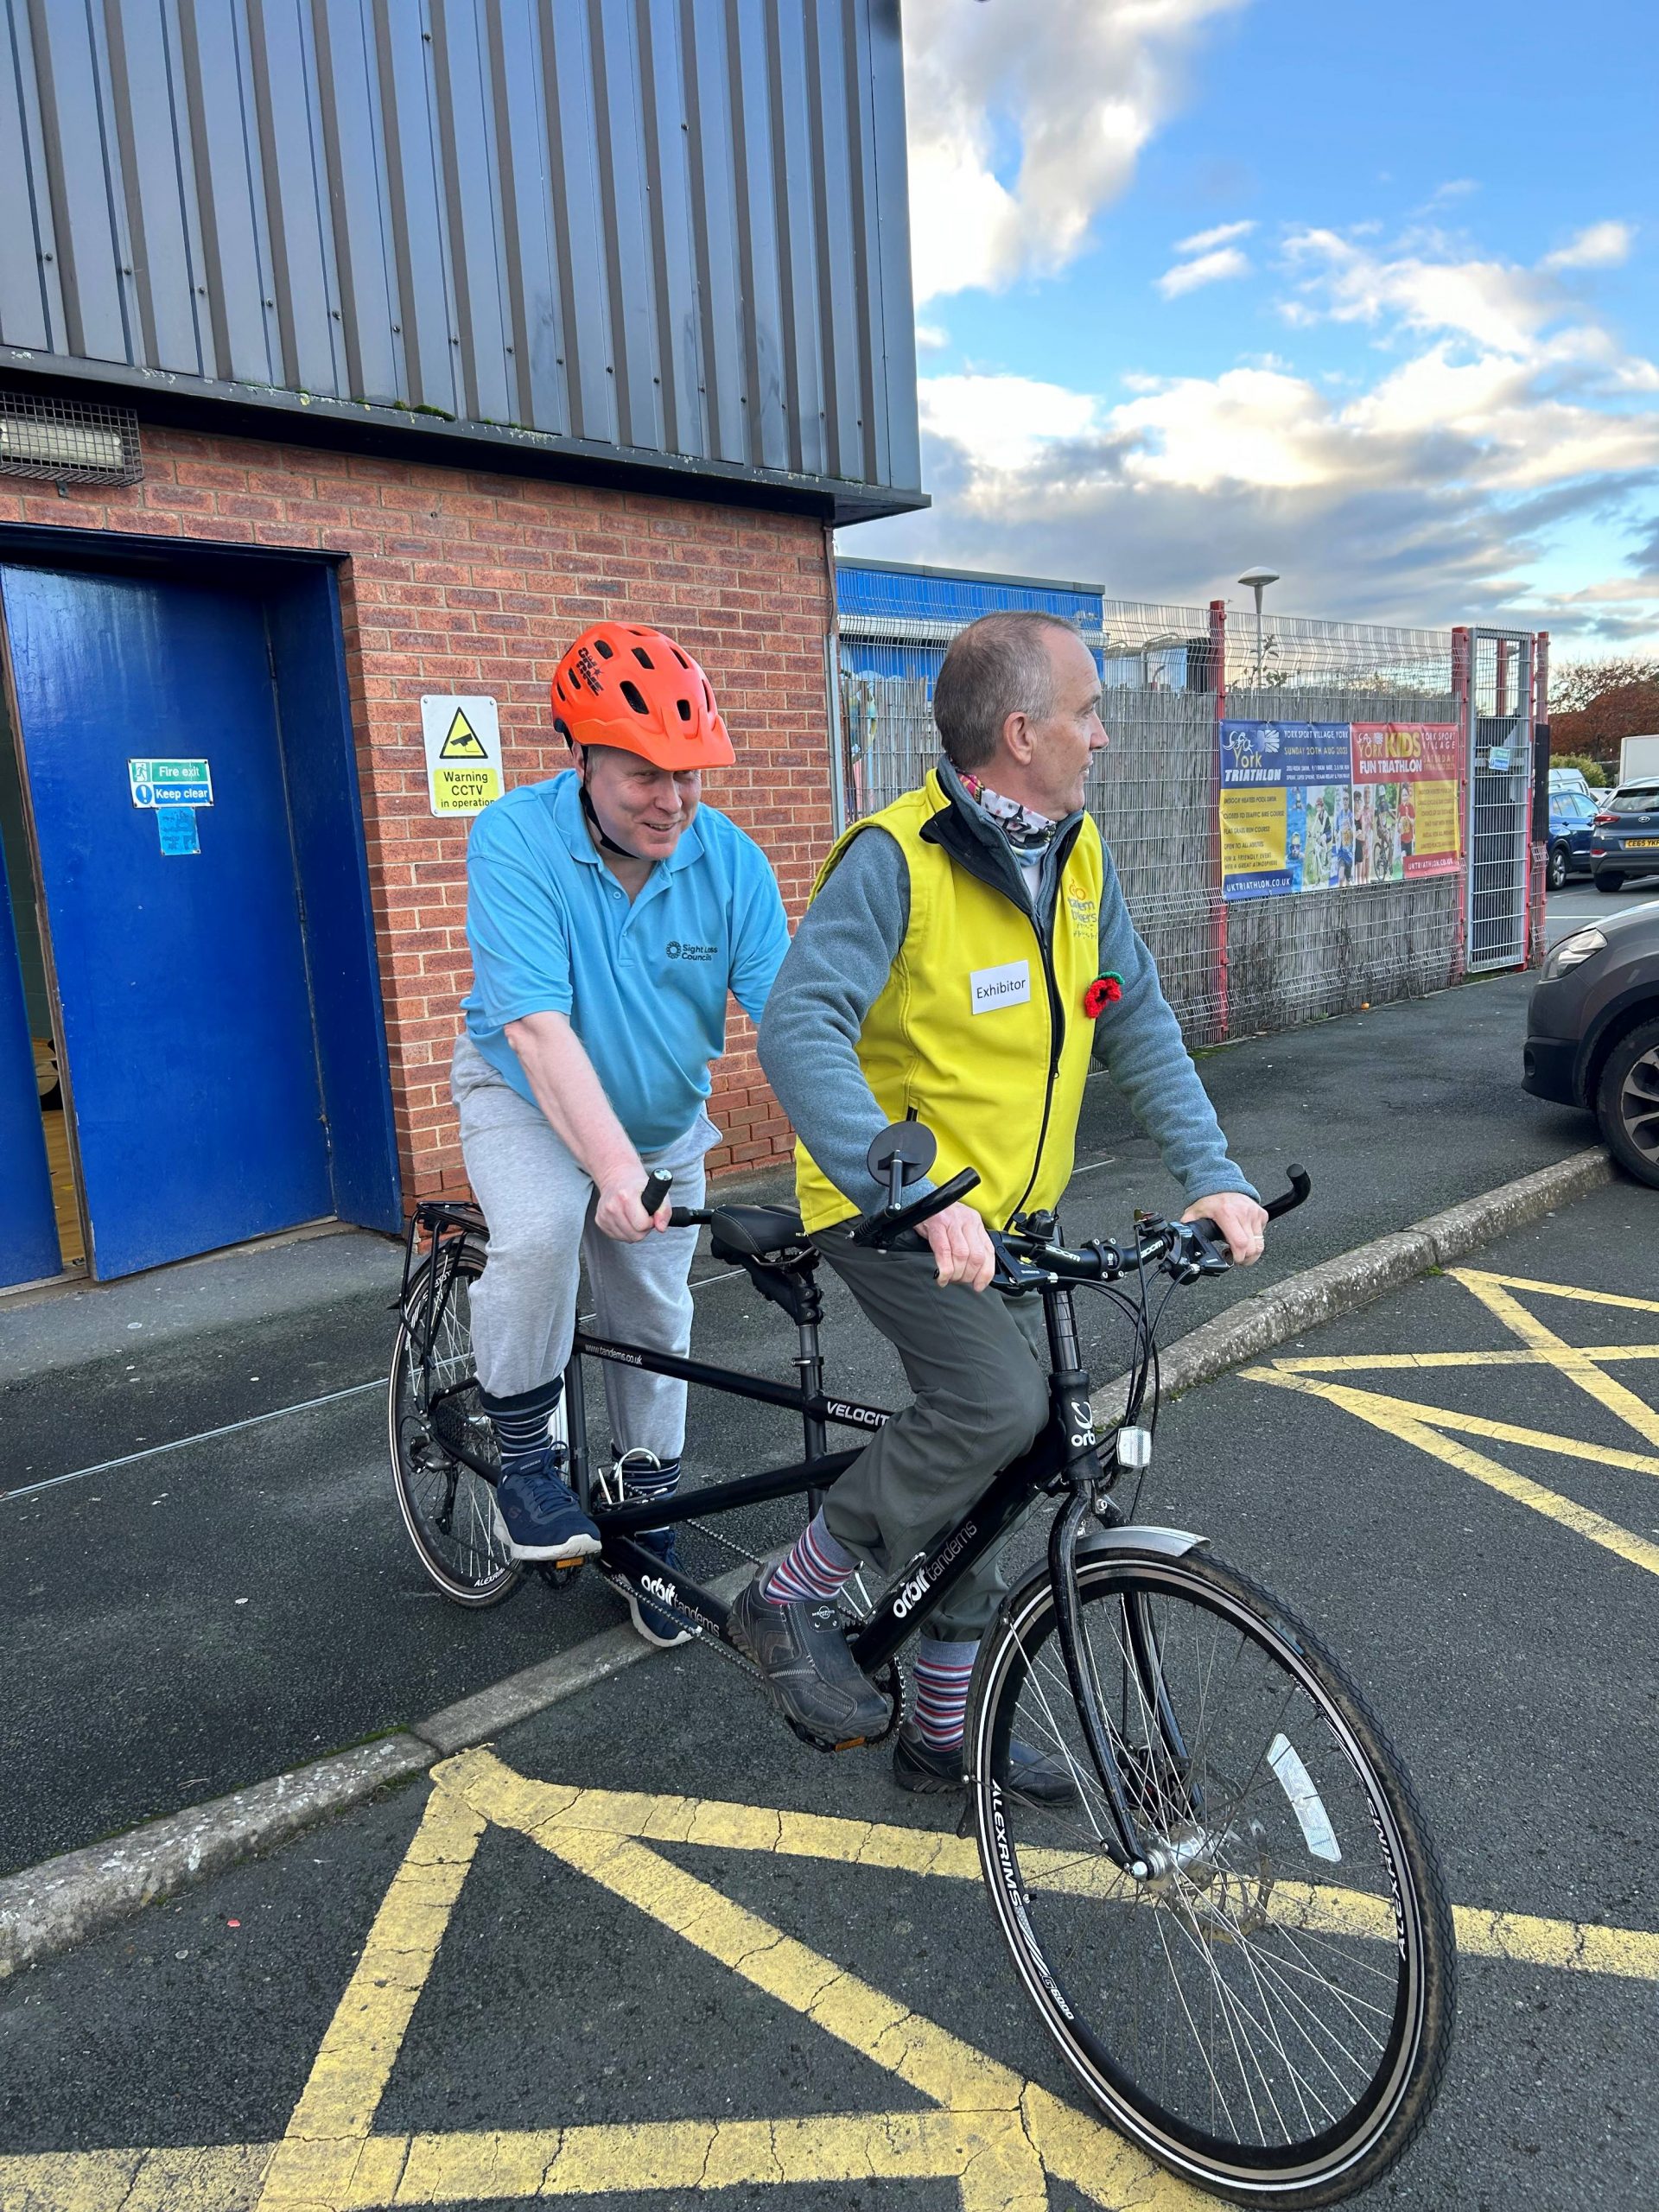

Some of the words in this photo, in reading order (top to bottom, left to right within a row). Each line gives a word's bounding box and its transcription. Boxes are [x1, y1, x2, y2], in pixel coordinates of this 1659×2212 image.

[1284, 730, 1298, 739] YORK
[1421, 732, 1437, 741] YORK
[1438, 732, 1456, 741] SPORT
[1358, 745, 1382, 758] YORK
[1385, 732, 1421, 758] KIDS
[1422, 741, 1455, 750] VILLAGE
[1284, 747, 1305, 755] SUNDAY
[1233, 747, 1262, 768] York
[159, 766, 179, 777] Fire
[182, 767, 200, 777] exit
[1360, 760, 1376, 774] FUN
[1378, 759, 1422, 773] TRIATHLON
[443, 772, 488, 783] Warning
[1224, 769, 1281, 782] TRIATHLON
[156, 788, 181, 800] Keep
[184, 788, 208, 798] clear
[451, 785, 483, 796] CCTV
[441, 798, 449, 808] in
[1226, 877, 1290, 892] UKTRIATHLON.CO.UK
[683, 944, 703, 954] Sight
[682, 952, 712, 961] Councils
[976, 978, 1026, 999] Exhibitor
[585, 1344, 643, 1365] www.tandems.co.uk
[992, 1777, 1023, 1908] ALEXRIMS
[1367, 1796, 1406, 1961] ALEXRIMS
